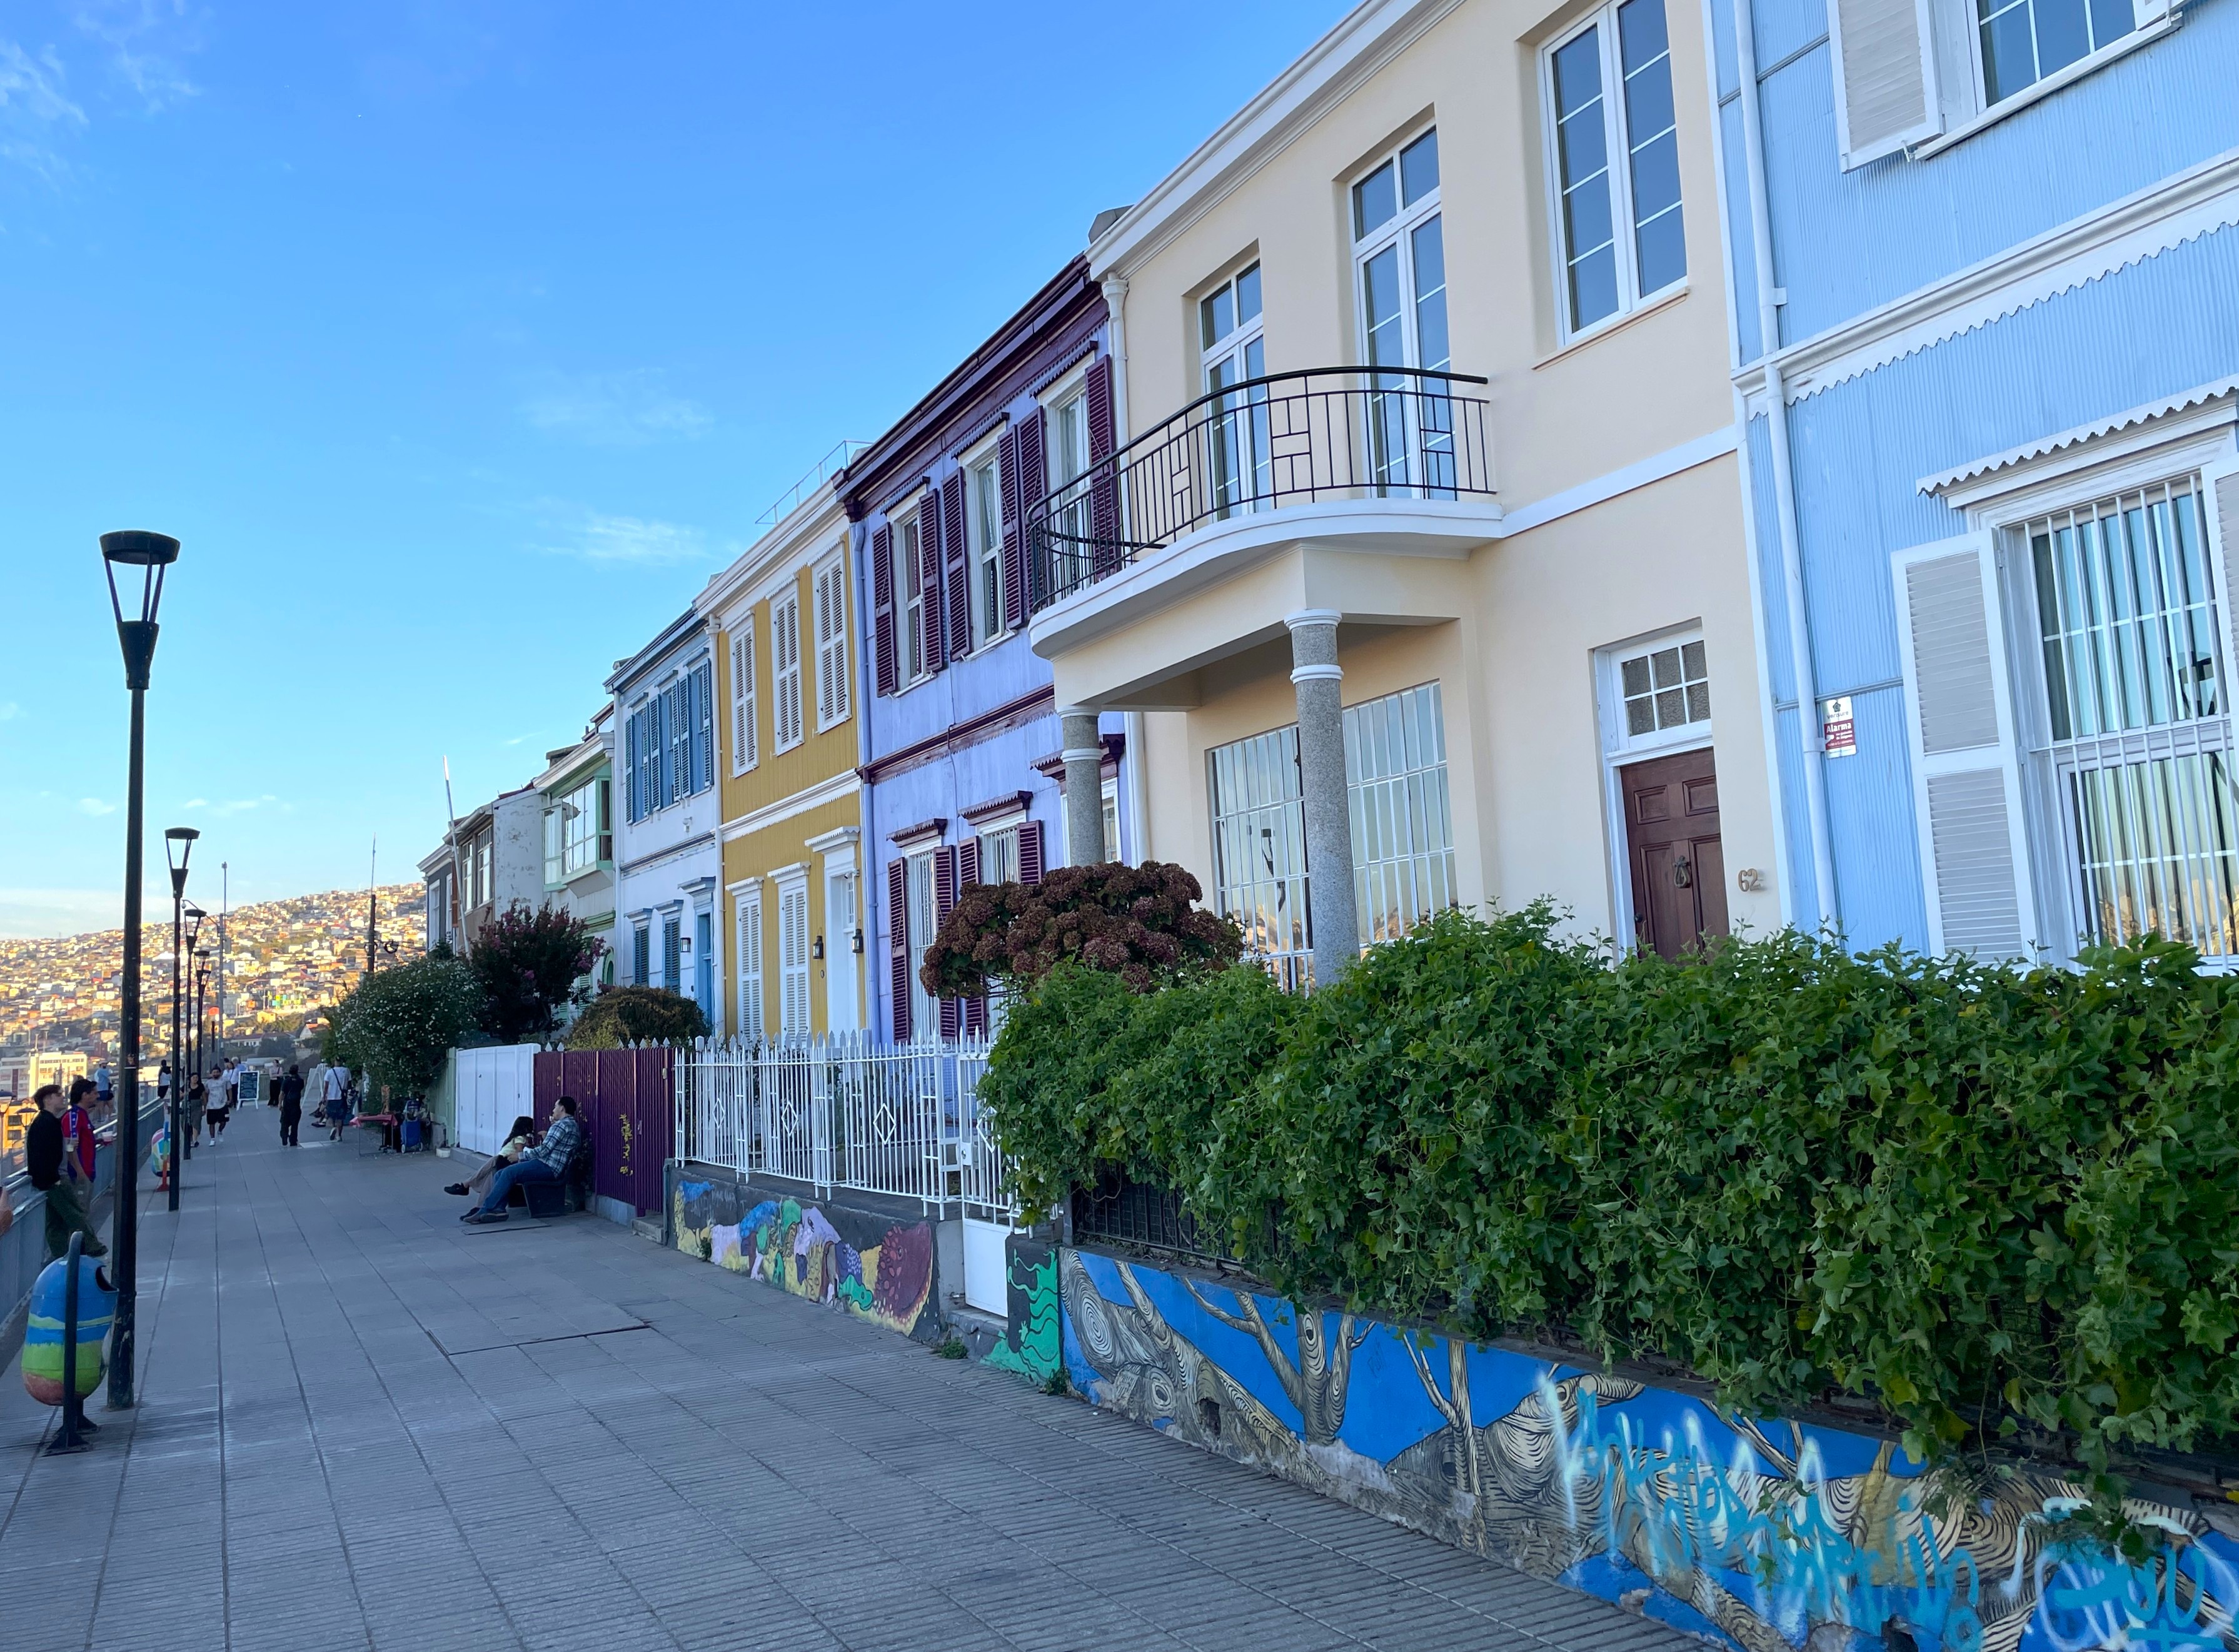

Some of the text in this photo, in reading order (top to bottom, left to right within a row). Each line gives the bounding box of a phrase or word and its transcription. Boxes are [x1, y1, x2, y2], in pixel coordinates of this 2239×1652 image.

[1826, 711, 1849, 719] verisure
[1826, 722, 1851, 733] Alarma
[1738, 868, 1761, 892] 62
